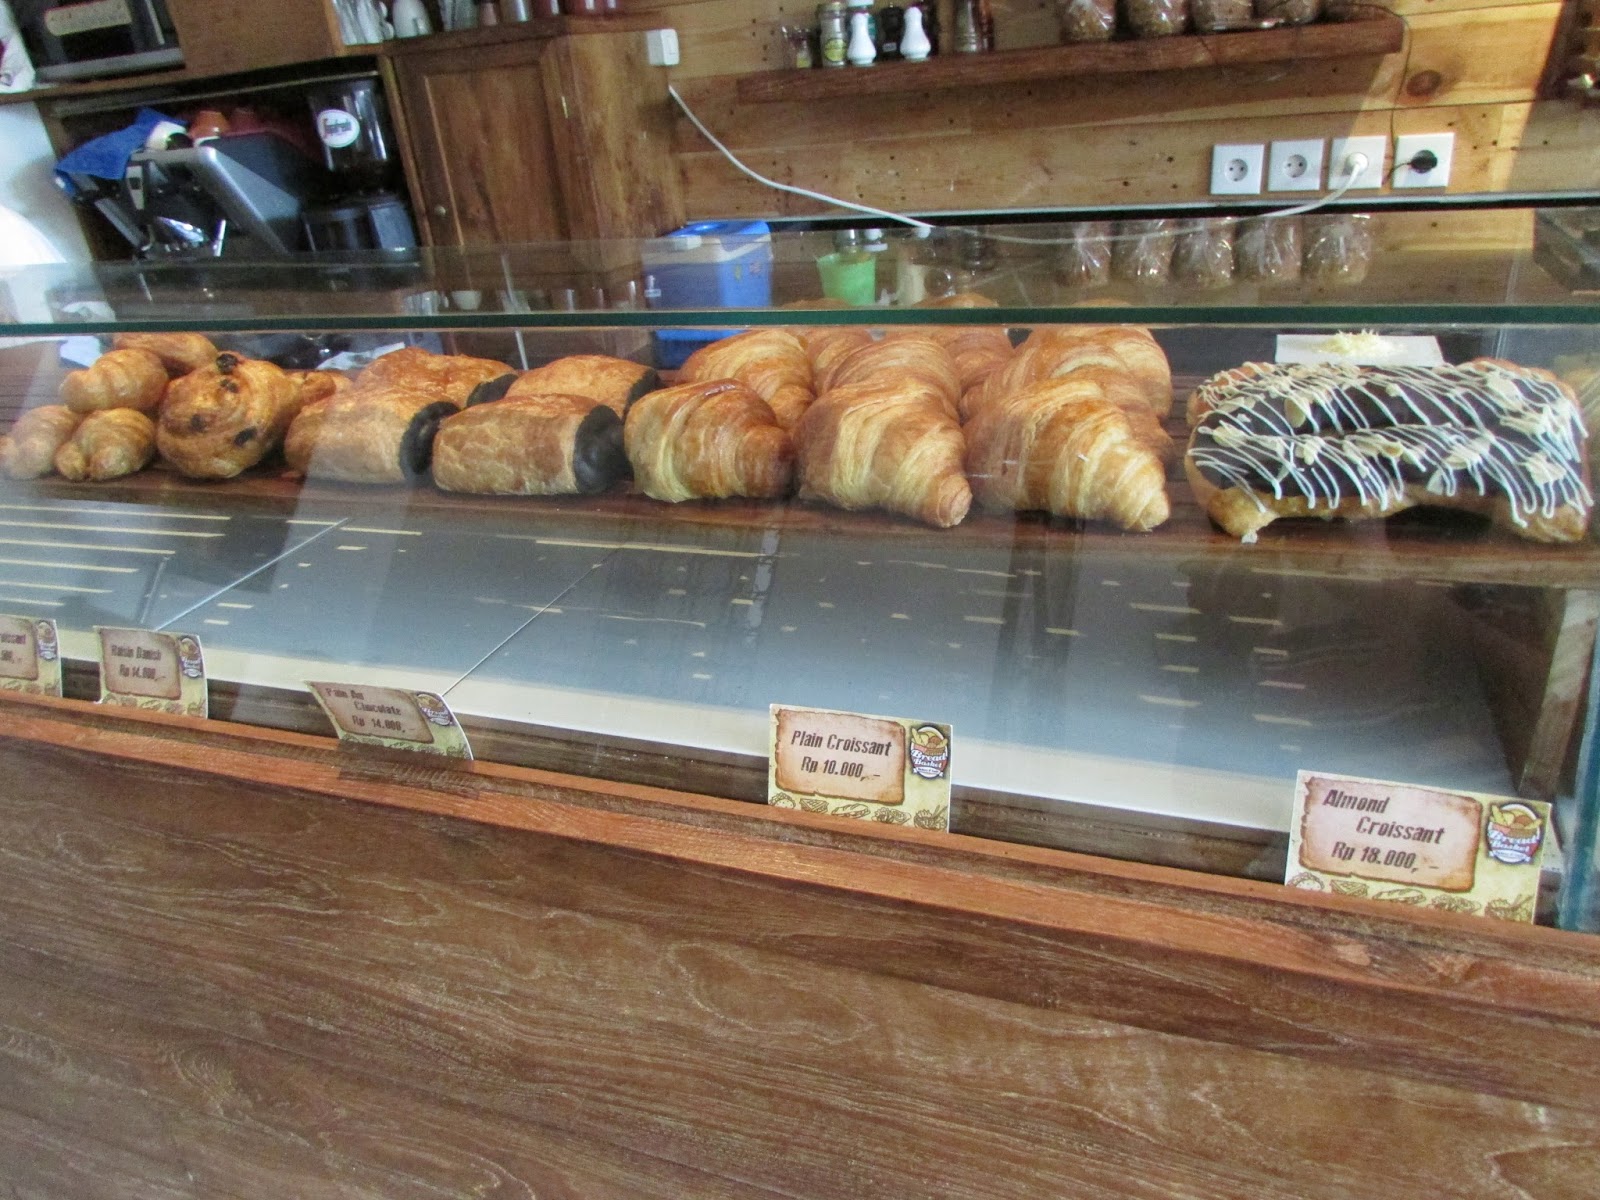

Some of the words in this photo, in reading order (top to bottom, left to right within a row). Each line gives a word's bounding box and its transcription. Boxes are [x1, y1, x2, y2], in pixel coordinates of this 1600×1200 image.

[791, 730, 824, 748] Plain
[826, 734, 893, 757] Croissant
[911, 749, 947, 761] Bread
[801, 756, 819, 773] Rp
[1323, 789, 1391, 815] Almond
[1356, 816, 1445, 845] Croissant
[1331, 841, 1356, 862] Rp
